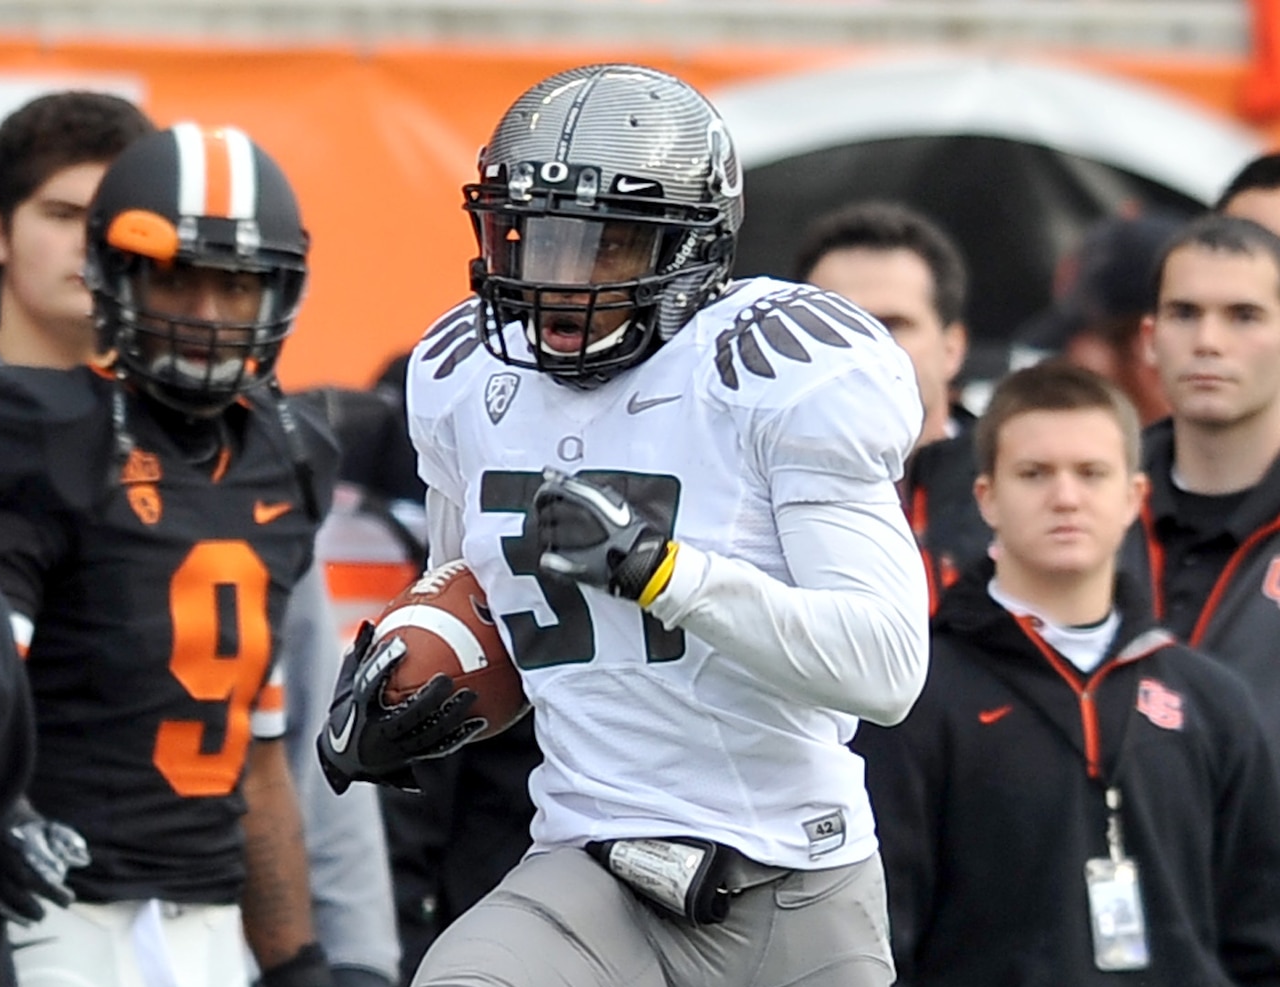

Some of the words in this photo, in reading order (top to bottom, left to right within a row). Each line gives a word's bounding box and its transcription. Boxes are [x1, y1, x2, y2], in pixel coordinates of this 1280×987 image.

[541, 161, 568, 182] O
[557, 436, 583, 462] O
[480, 469, 686, 671] 37
[154, 538, 270, 796] 9
[816, 821, 834, 835] 42
